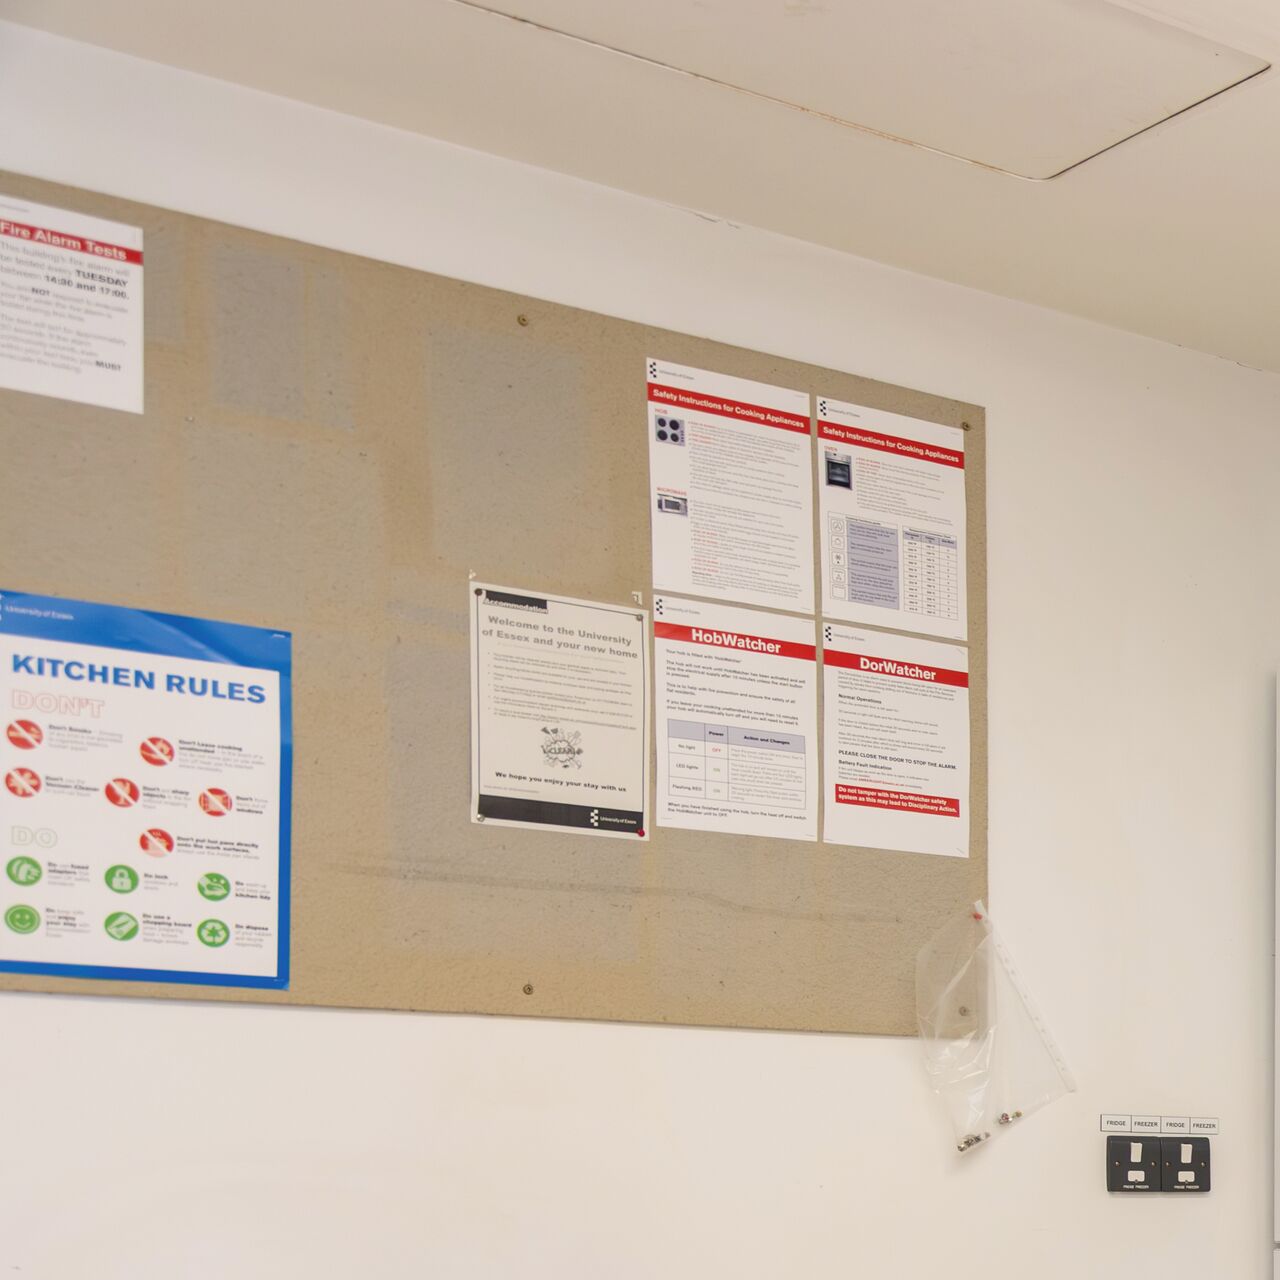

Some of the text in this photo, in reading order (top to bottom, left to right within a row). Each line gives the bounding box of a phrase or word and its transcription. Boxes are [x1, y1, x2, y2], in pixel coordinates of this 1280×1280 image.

[1, 221, 126, 260] Fire Alarm Tests
[31, 286, 49, 296] NOT
[76, 269, 128, 288] TUESDAY
[76, 281, 96, 292] and
[95, 359, 120, 371] MUST
[653, 389, 804, 429] Safety Instructions for Cooking Appliances
[823, 426, 959, 463] Safety Instructions for Cooking Appliances
[482, 627, 637, 659] of Essex and your new home
[488, 615, 631, 647] Welcome to the University
[691, 628, 781, 654] HobWatcher
[11, 652, 266, 705] KITCHEN RULES
[860, 658, 936, 681] DorWatcher
[11, 687, 105, 719] DON'T
[508, 773, 526, 781] hope
[544, 777, 563, 786] enjoy
[565, 780, 581, 788] your
[583, 782, 598, 790] stay
[838, 793, 857, 801] system
[908, 802, 938, 811] Disciplinary
[857, 788, 876, 796] tamper
[899, 794, 929, 803] DorWatcher
[11, 824, 57, 849] DO
